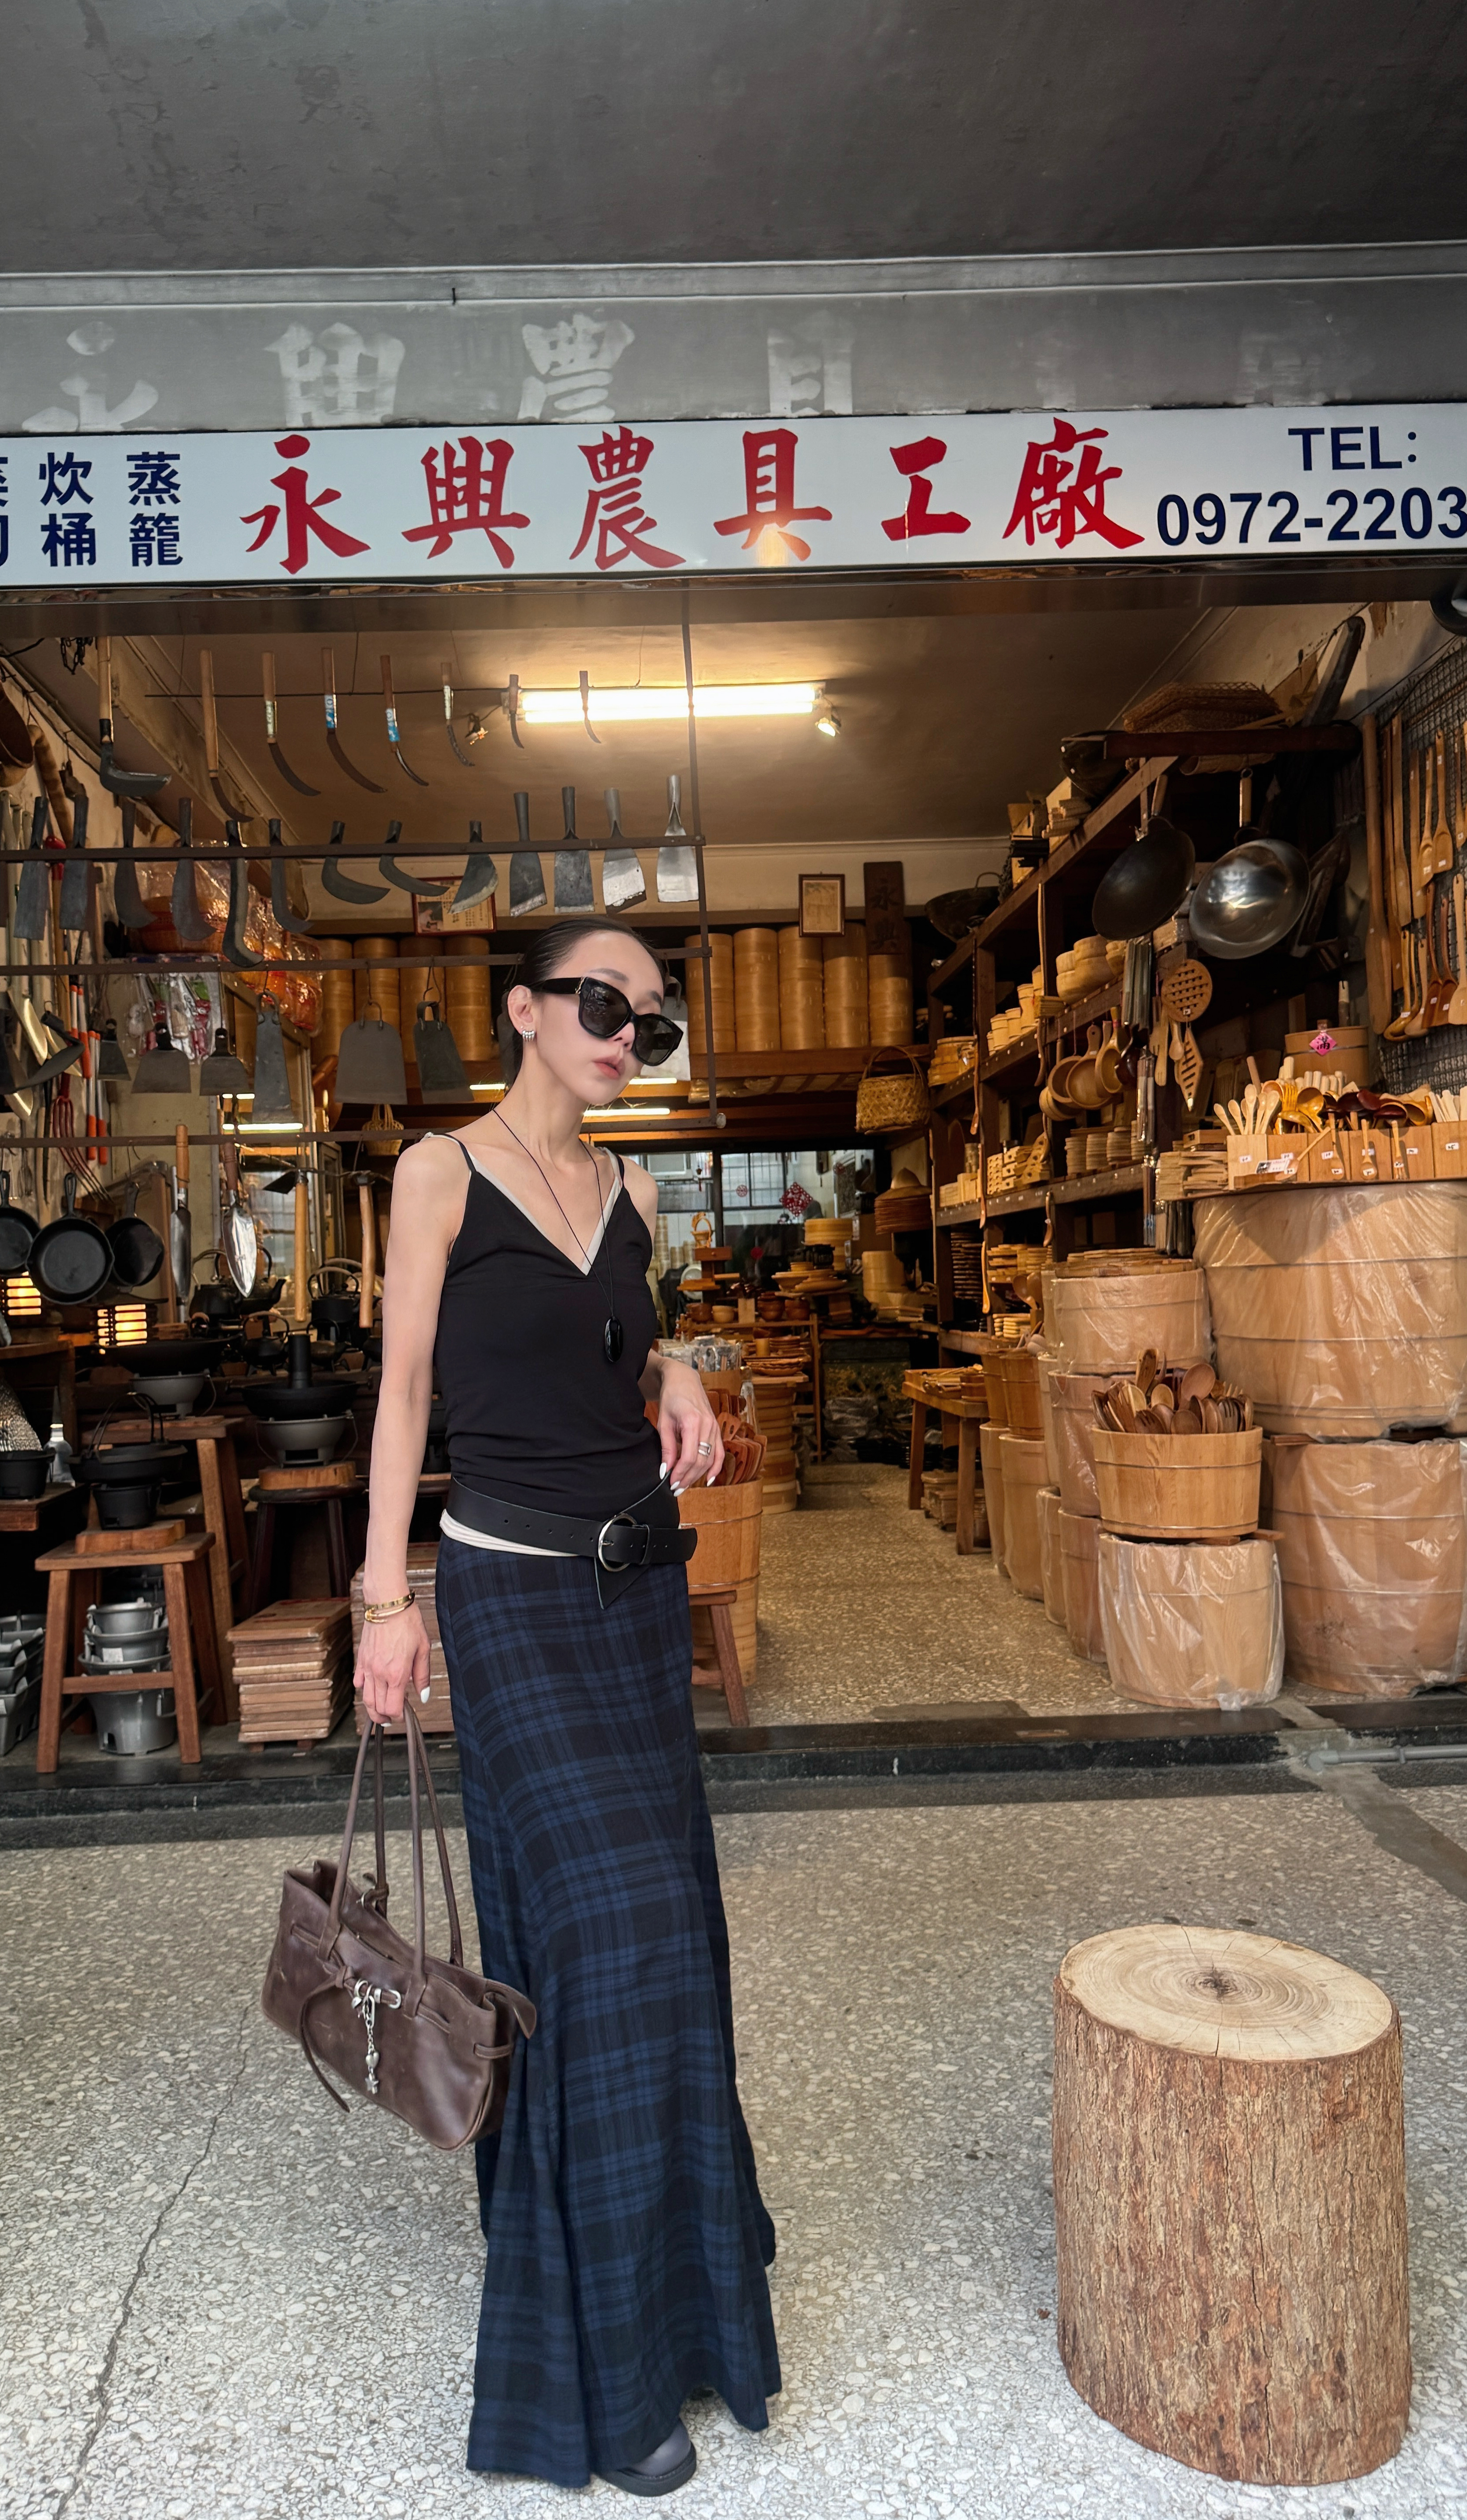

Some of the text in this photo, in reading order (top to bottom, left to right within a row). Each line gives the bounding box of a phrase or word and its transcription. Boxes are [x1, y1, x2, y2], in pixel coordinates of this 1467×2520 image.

[241, 419, 1145, 574] 永興農具工廠
[1288, 426, 1416, 471] TEL:
[39, 452, 96, 567] 炊桶
[126, 451, 183, 567] 蒸籠
[1157, 486, 1467, 546] 0972-2203
